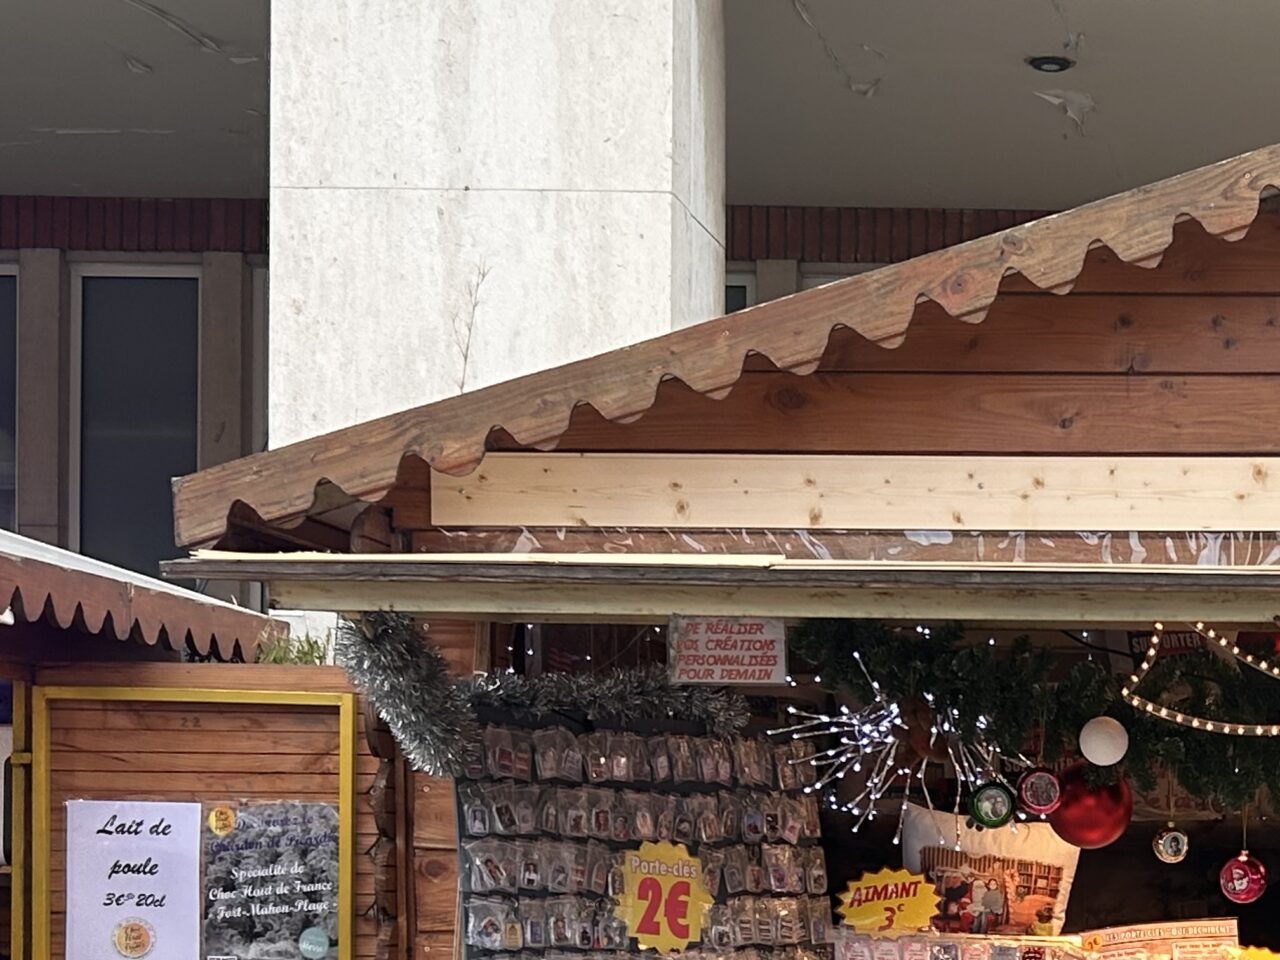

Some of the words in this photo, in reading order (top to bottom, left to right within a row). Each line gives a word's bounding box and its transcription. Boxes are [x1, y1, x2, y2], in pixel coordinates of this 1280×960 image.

[685, 622, 700, 634] DE
[705, 619, 764, 635] RÉALISER
[676, 639, 699, 652] VOS
[705, 636, 775, 651] CRÉATIONS
[677, 651, 778, 666] PERSONNALISÉES
[678, 668, 715, 680] POUR
[720, 668, 773, 680] DEMAIN
[96, 814, 144, 836] Lait
[149, 818, 172, 836] de
[108, 857, 159, 880] poule
[631, 856, 697, 877] Porte-clés
[208, 888, 237, 902] Choc
[276, 882, 289, 895] de
[292, 880, 333, 894] France
[849, 880, 922, 908] AIMANT
[635, 876, 691, 939] 2€
